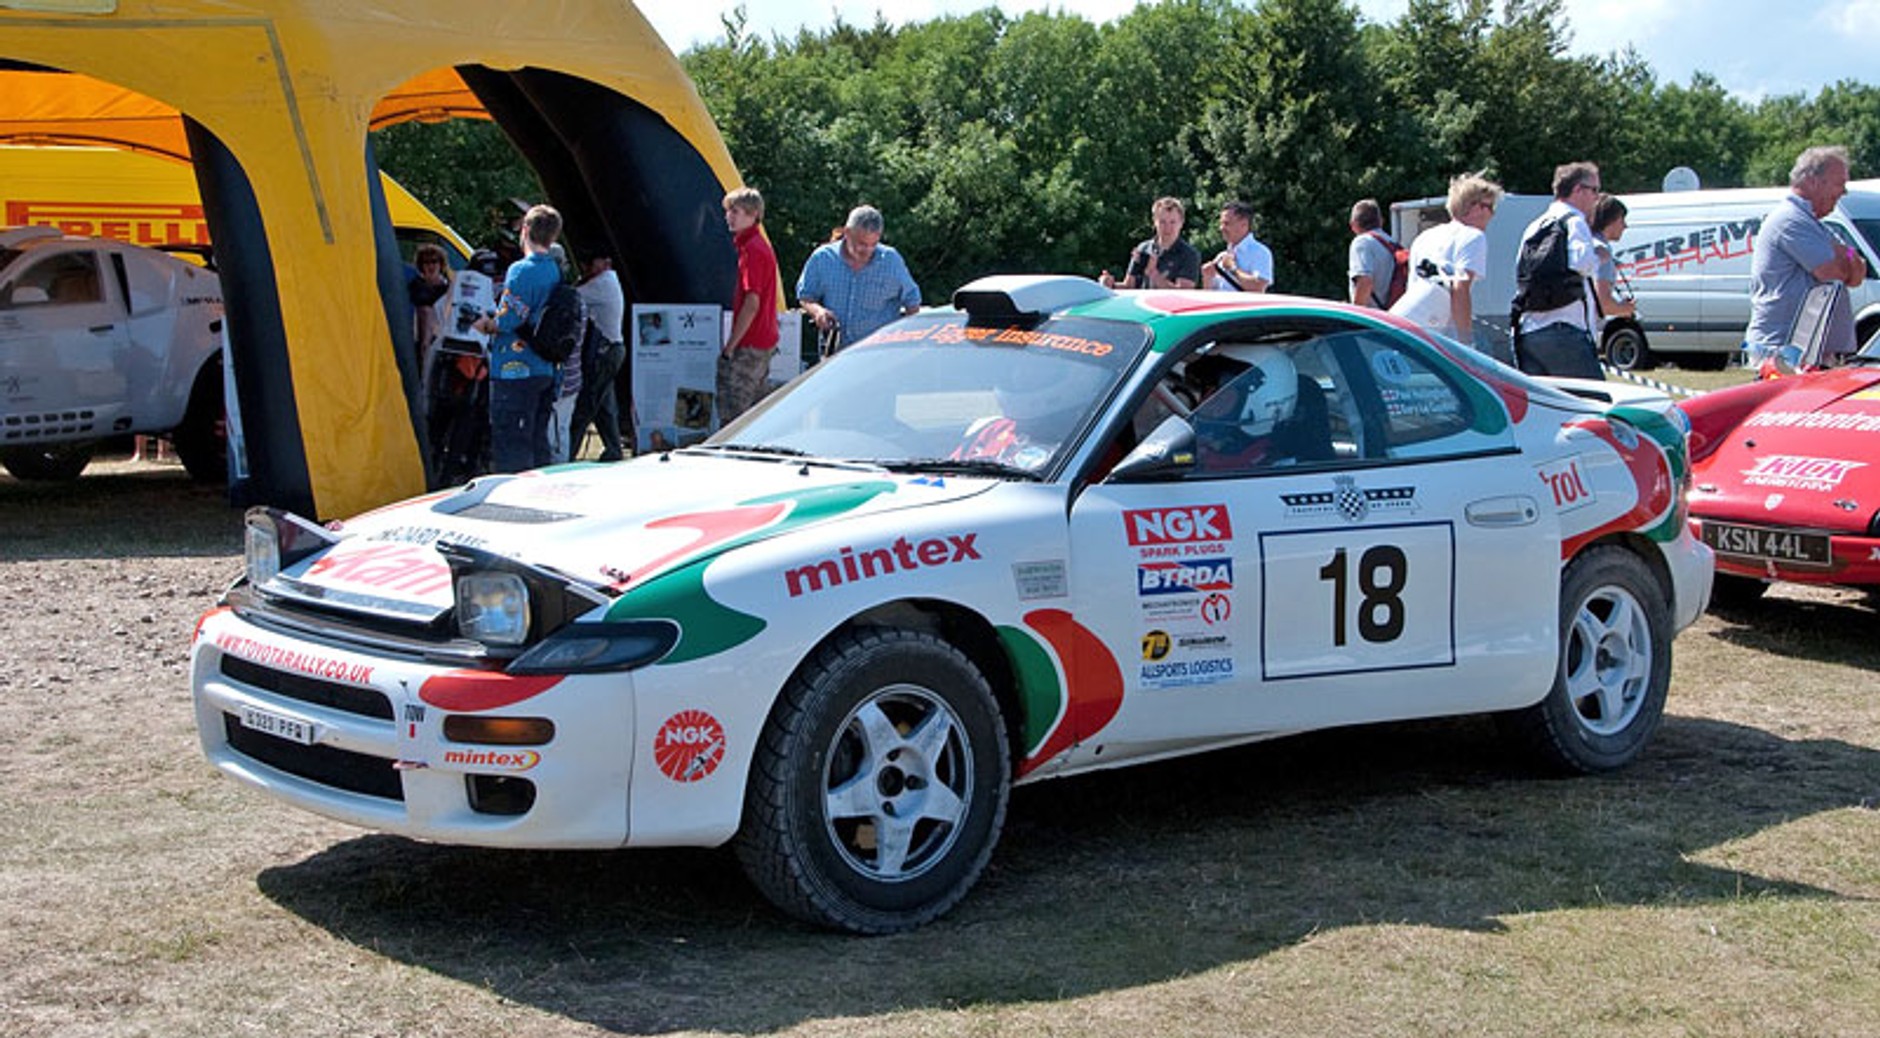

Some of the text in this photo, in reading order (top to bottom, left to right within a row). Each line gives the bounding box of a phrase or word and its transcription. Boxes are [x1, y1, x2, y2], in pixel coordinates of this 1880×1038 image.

[1133, 507, 1222, 543] NGK
[1140, 544, 1226, 559] SPARK PLUGS
[1716, 526, 1810, 560] KSN 44L
[785, 532, 982, 598] mintex
[1142, 563, 1231, 589] BTRDA
[1319, 544, 1408, 648] 18
[1141, 657, 1234, 679] ALLSPORTS LOGISTICS
[404, 703, 427, 723] TOW
[664, 726, 713, 746] NGK
[445, 748, 527, 768] mintex
